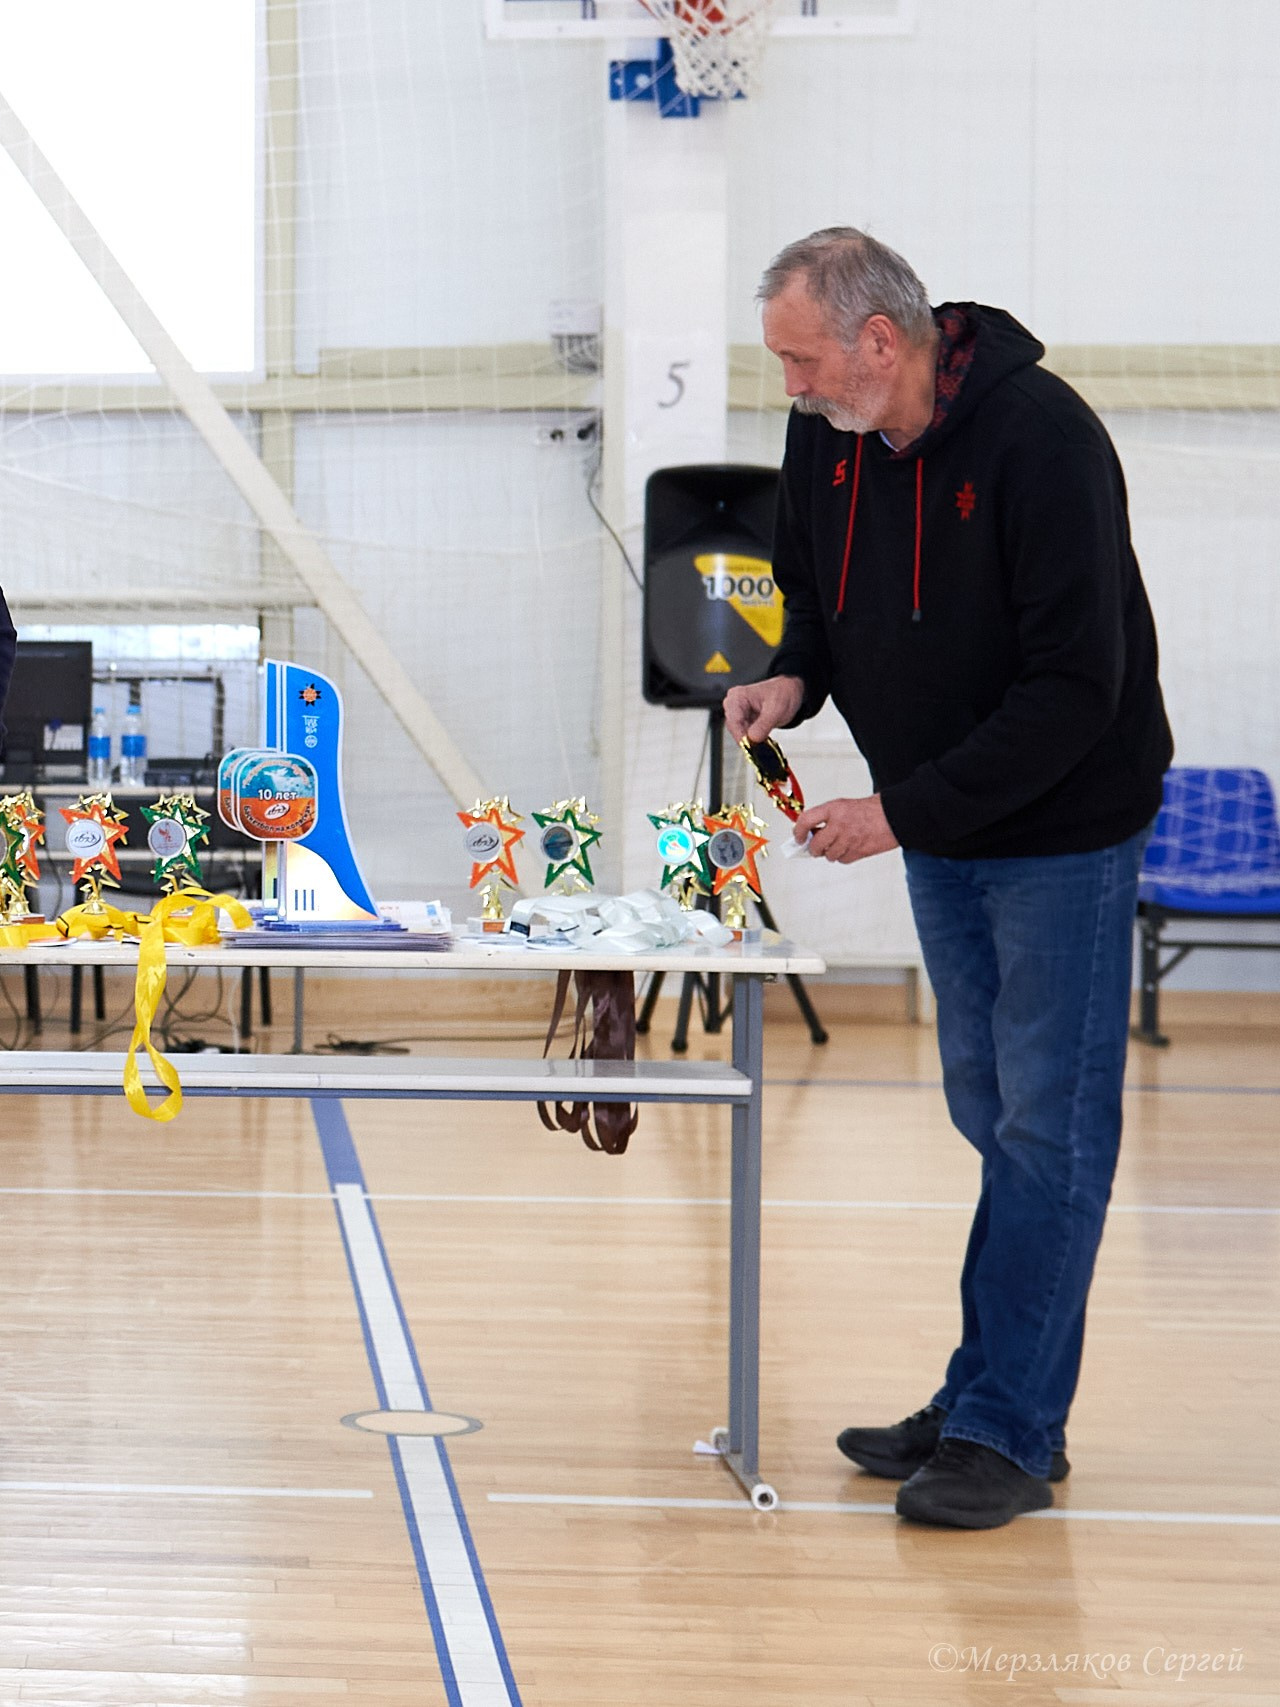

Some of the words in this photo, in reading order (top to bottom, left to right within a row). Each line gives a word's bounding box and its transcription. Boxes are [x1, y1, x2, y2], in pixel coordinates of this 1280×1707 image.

[657, 360, 690, 408] 5
[258, 789, 272, 800] 10
[275, 791, 297, 800] лет
